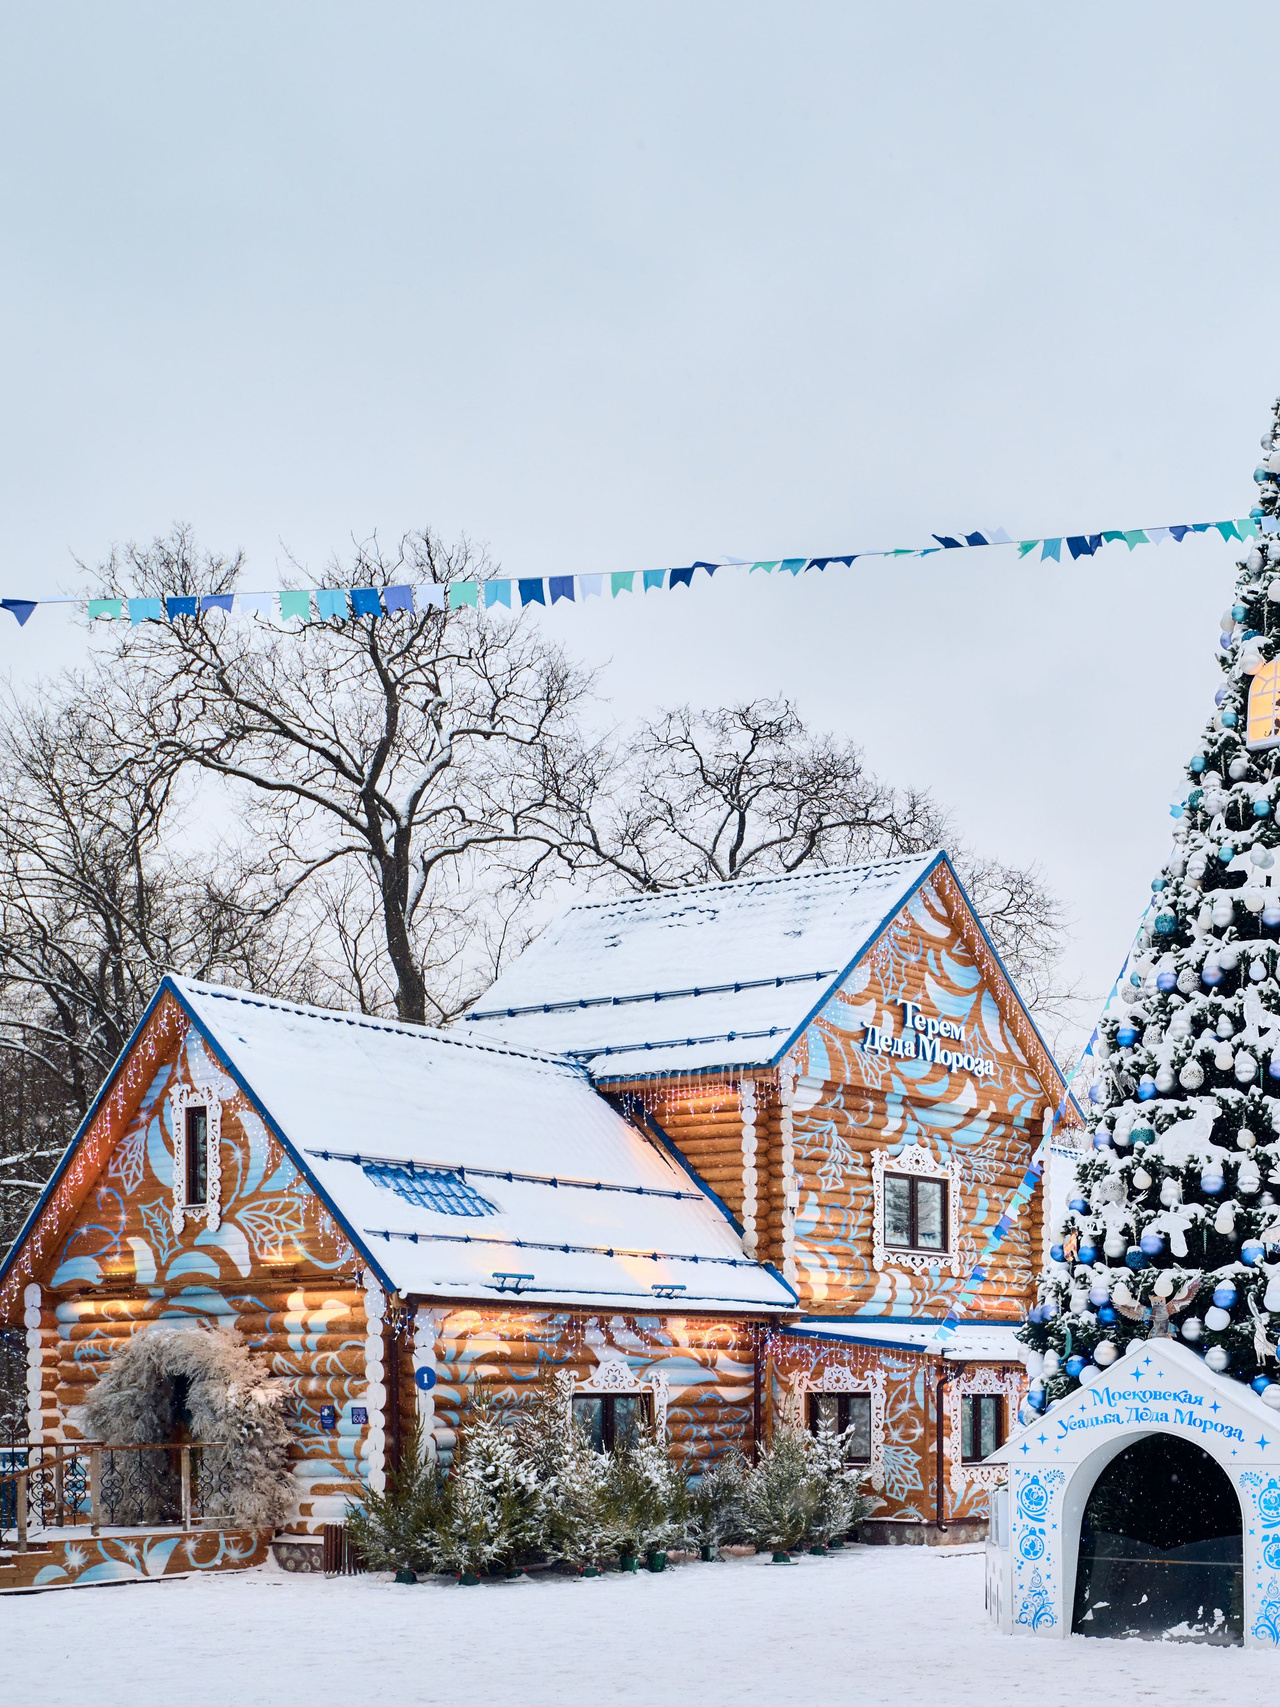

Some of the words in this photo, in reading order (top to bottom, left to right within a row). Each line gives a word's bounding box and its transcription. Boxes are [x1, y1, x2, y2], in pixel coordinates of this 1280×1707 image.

[898, 999, 966, 1042] Терем
[862, 1021, 916, 1058] Деда
[917, 1034, 997, 1077] Мороза
[423, 1373, 428, 1384] 1
[1088, 1386, 1204, 1407] Московская
[1057, 1414, 1124, 1439] Усадьба
[1126, 1408, 1170, 1423] Деда
[1173, 1408, 1245, 1442] Мороза
